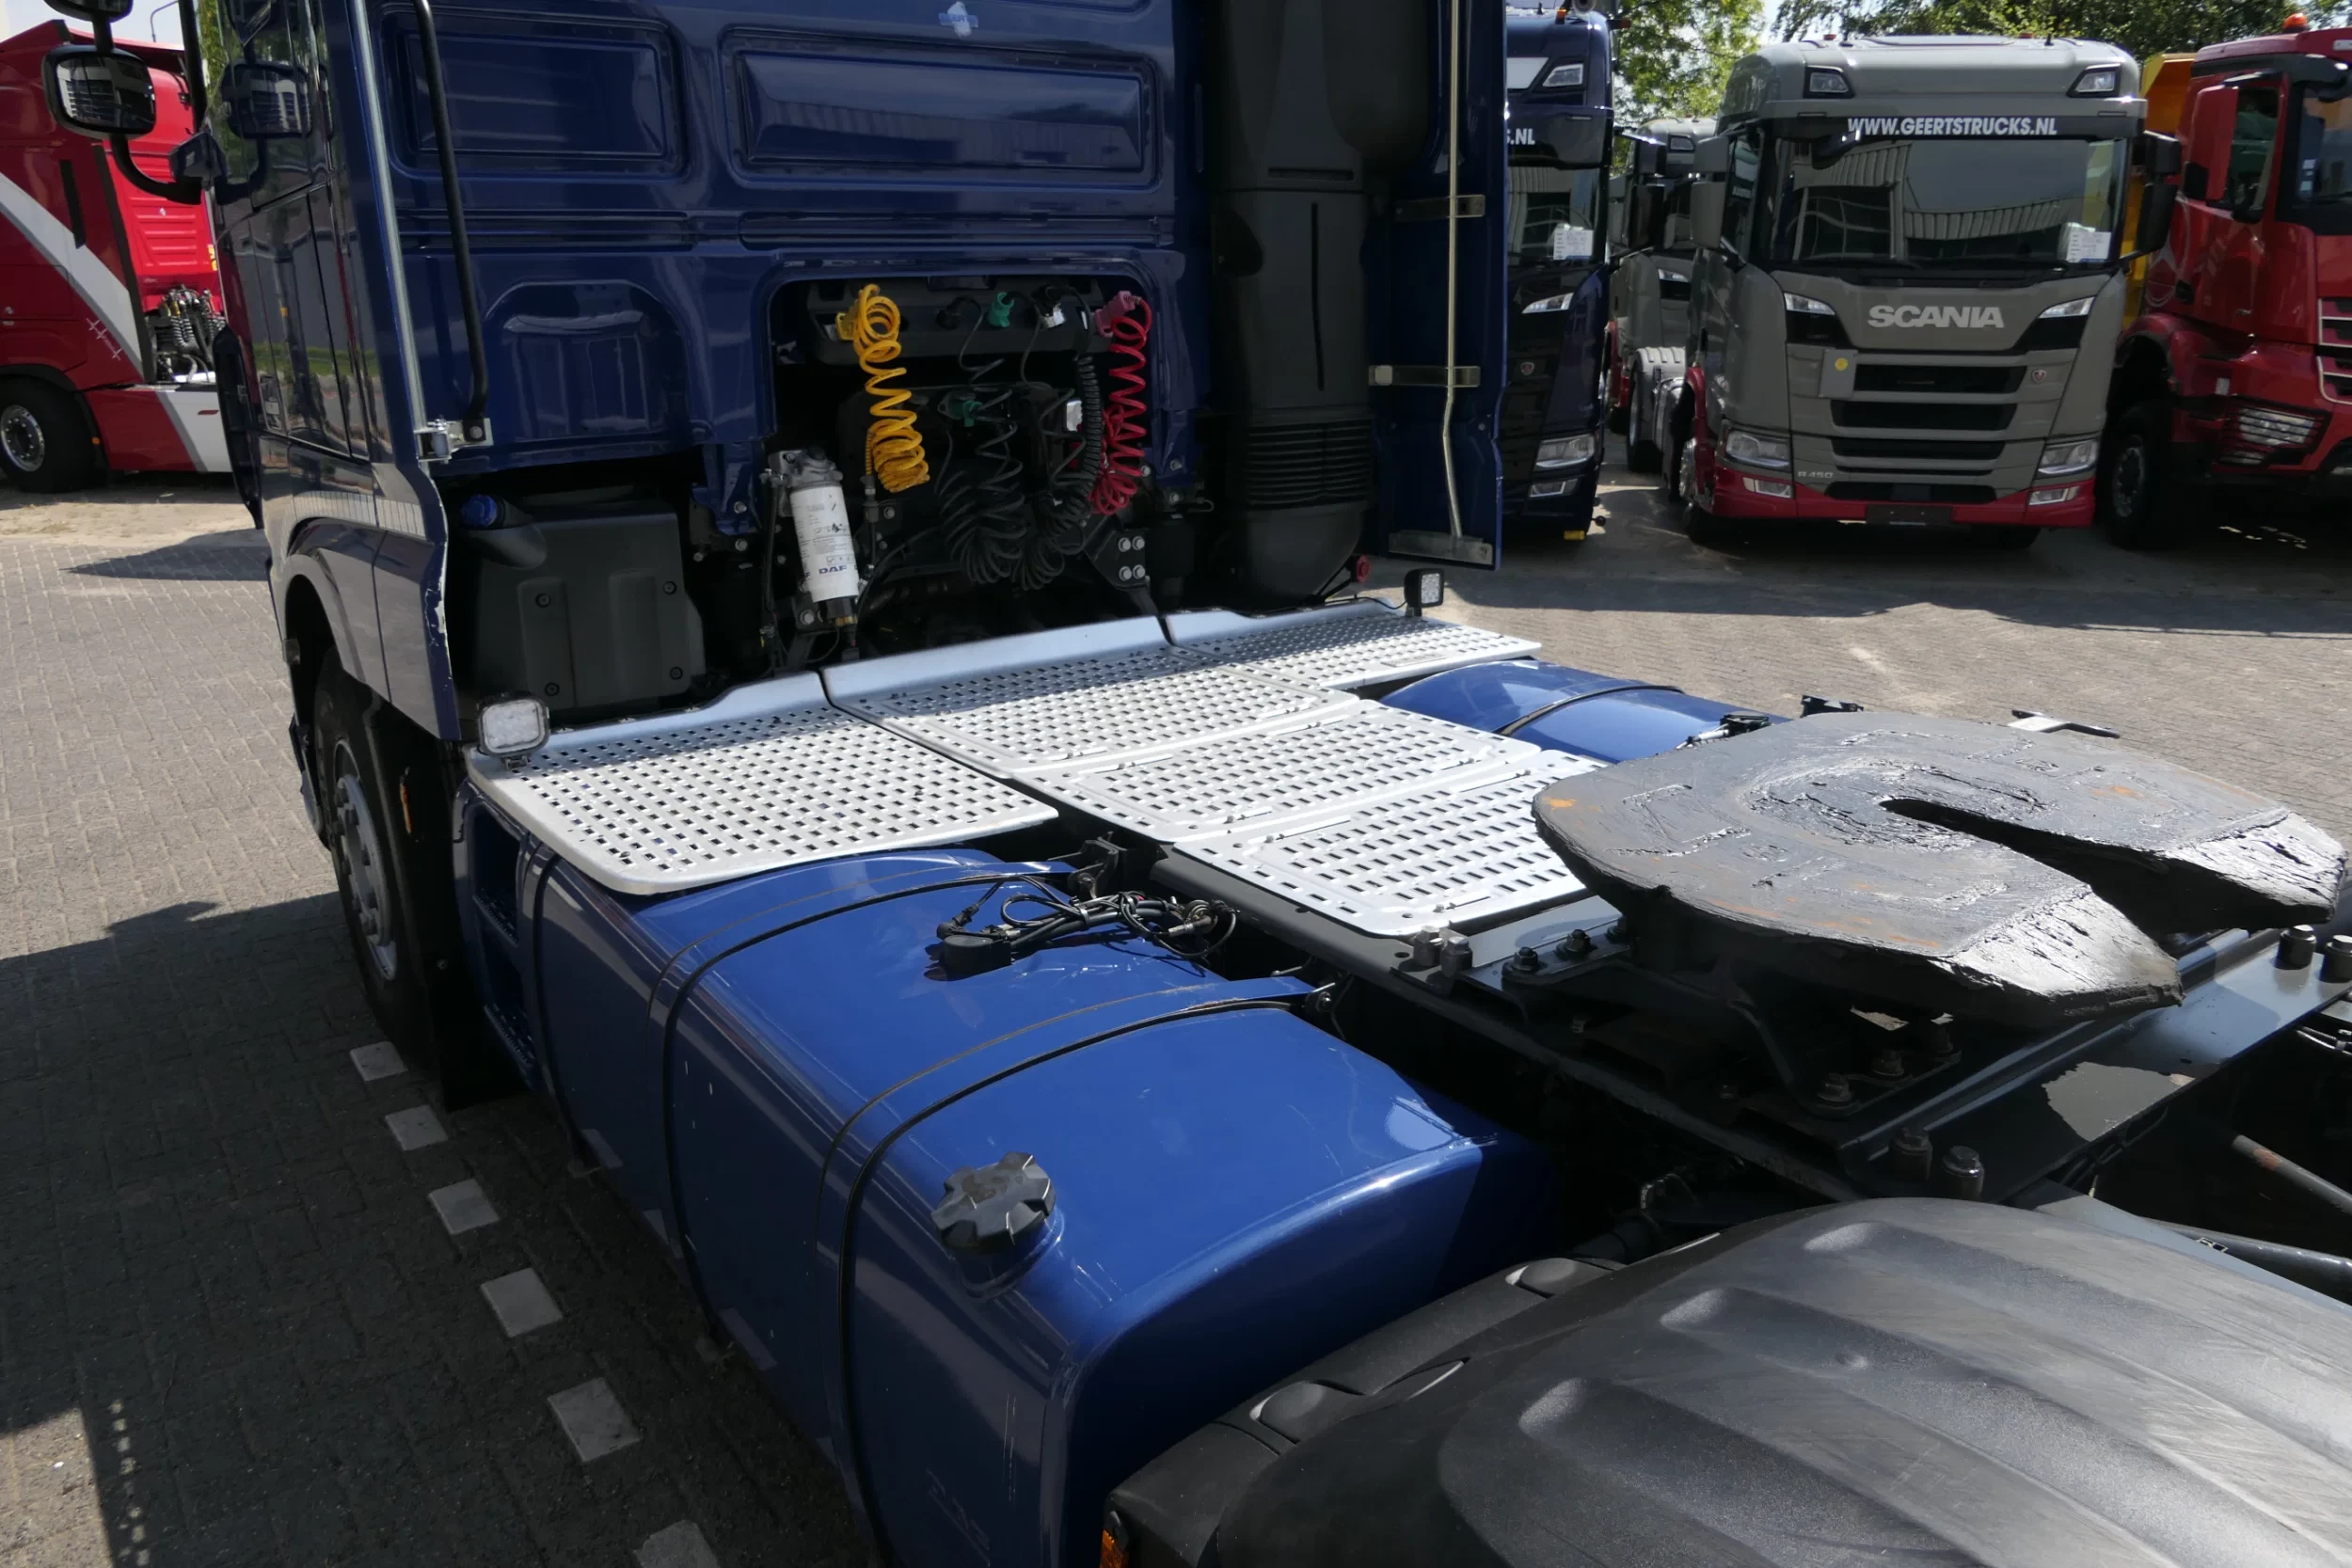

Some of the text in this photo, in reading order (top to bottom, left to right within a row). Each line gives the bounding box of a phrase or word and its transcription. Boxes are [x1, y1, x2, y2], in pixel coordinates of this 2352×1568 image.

[1847, 117, 2058, 135] WWW.GEERTSTRUCKS.NL
[1507, 128, 1535, 145] .NL
[1867, 305, 2004, 328] SCANIA
[818, 564, 848, 575] DAF
